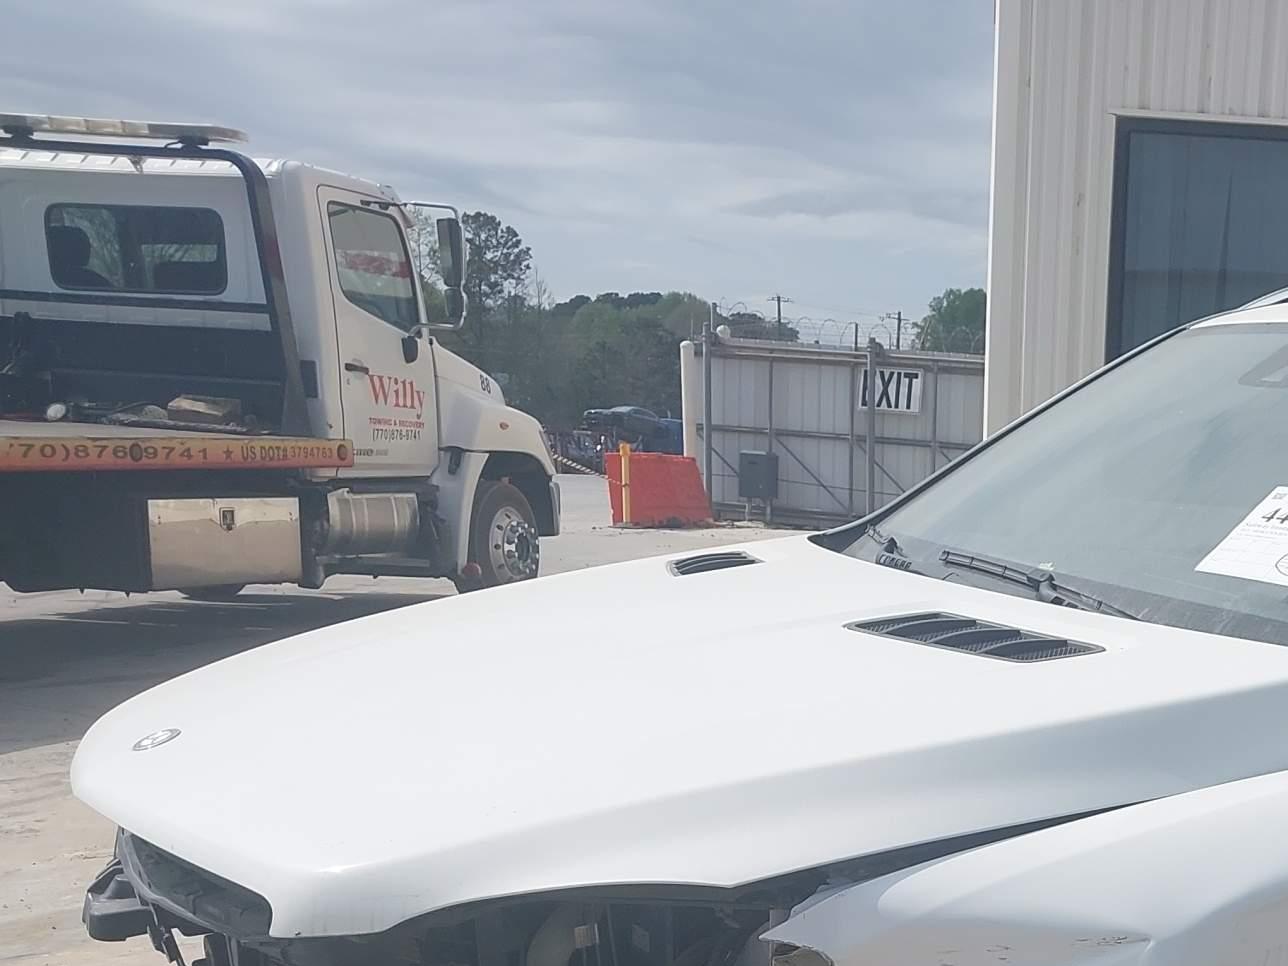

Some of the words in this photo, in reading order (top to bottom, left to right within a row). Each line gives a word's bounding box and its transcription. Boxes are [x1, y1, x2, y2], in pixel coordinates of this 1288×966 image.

[480, 373, 492, 395] 88
[368, 373, 425, 420] Willy
[372, 428, 421, 442] (770)876-9741
[241, 445, 257, 461] US
